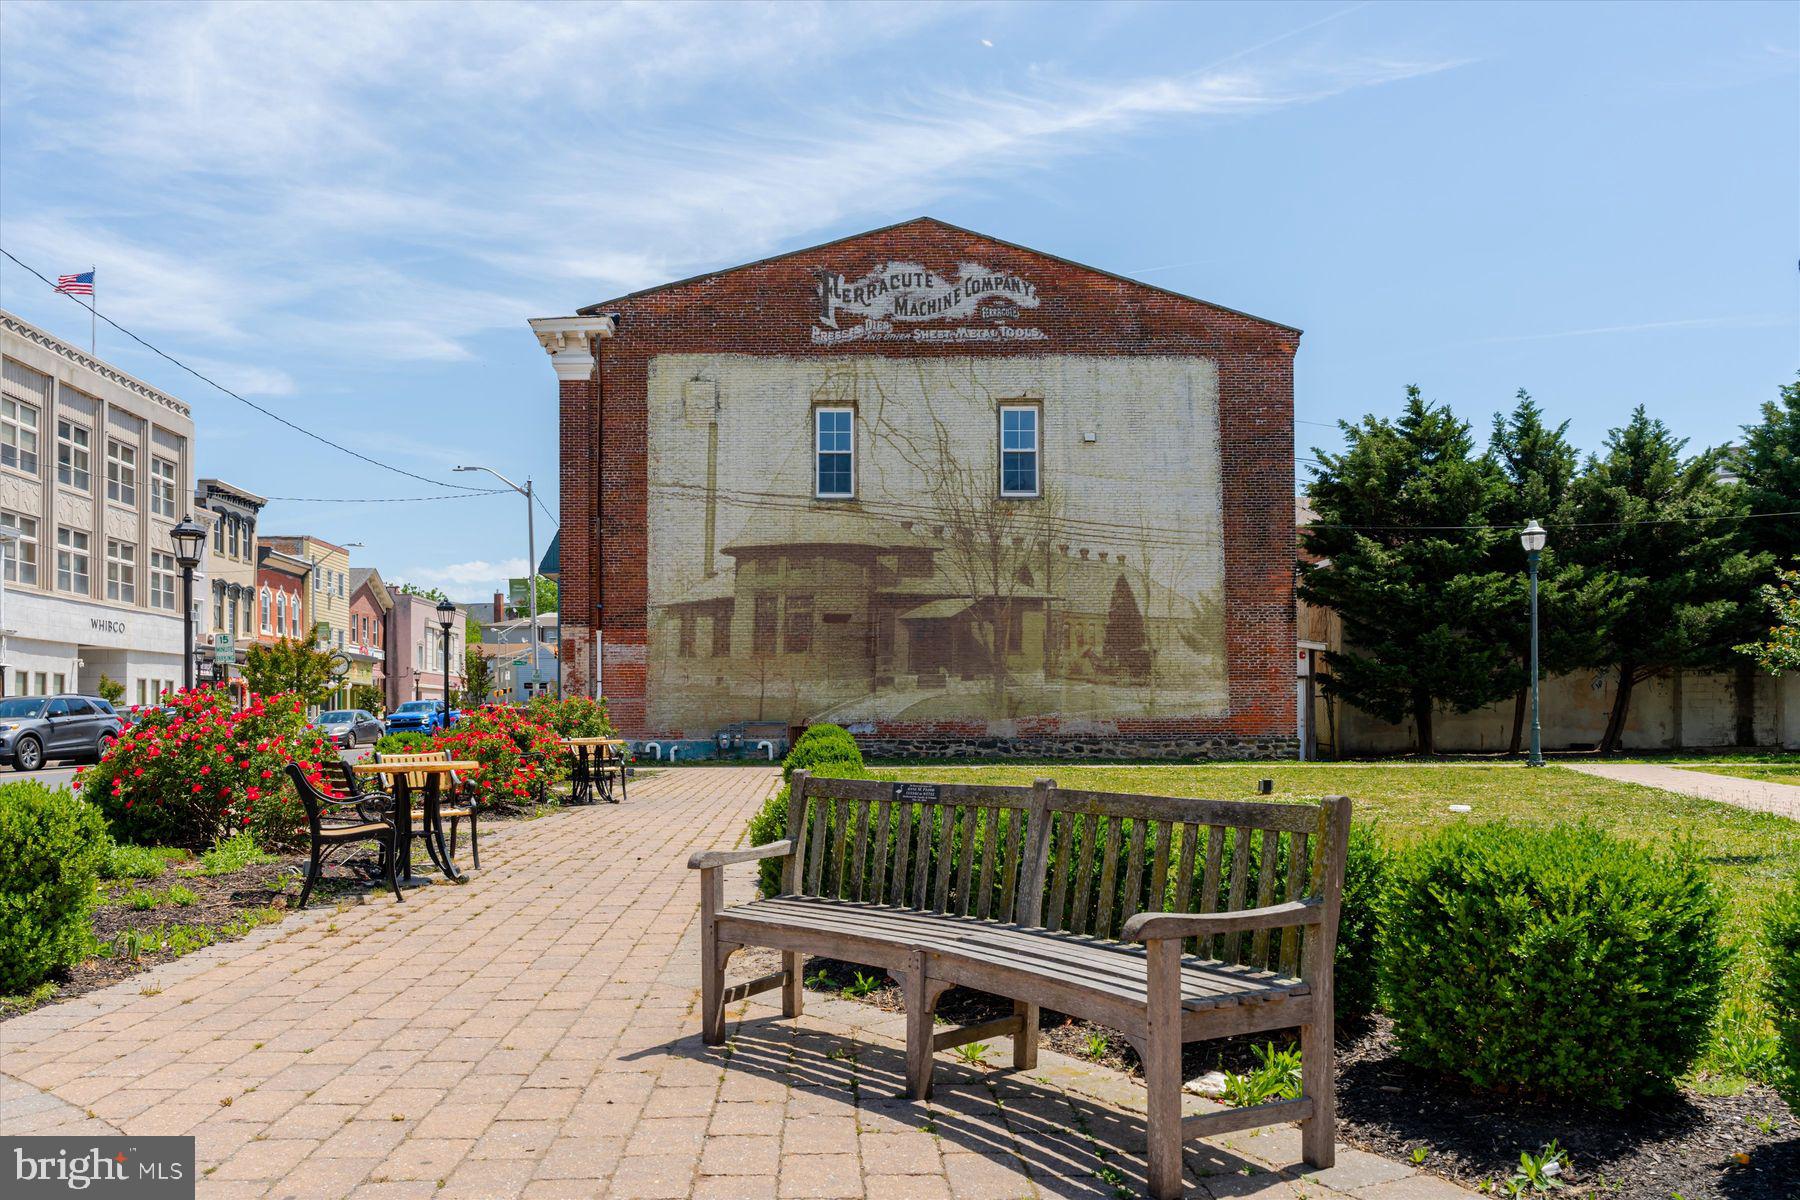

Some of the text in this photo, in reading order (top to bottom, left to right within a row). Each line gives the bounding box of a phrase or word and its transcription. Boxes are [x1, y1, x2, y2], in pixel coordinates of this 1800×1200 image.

[813, 271, 934, 320] FERRACUTE
[965, 275, 1032, 297] COMPANY
[894, 288, 961, 317] MACHINE
[91, 618, 125, 633] WHIBCO
[219, 635, 229, 644] 15
